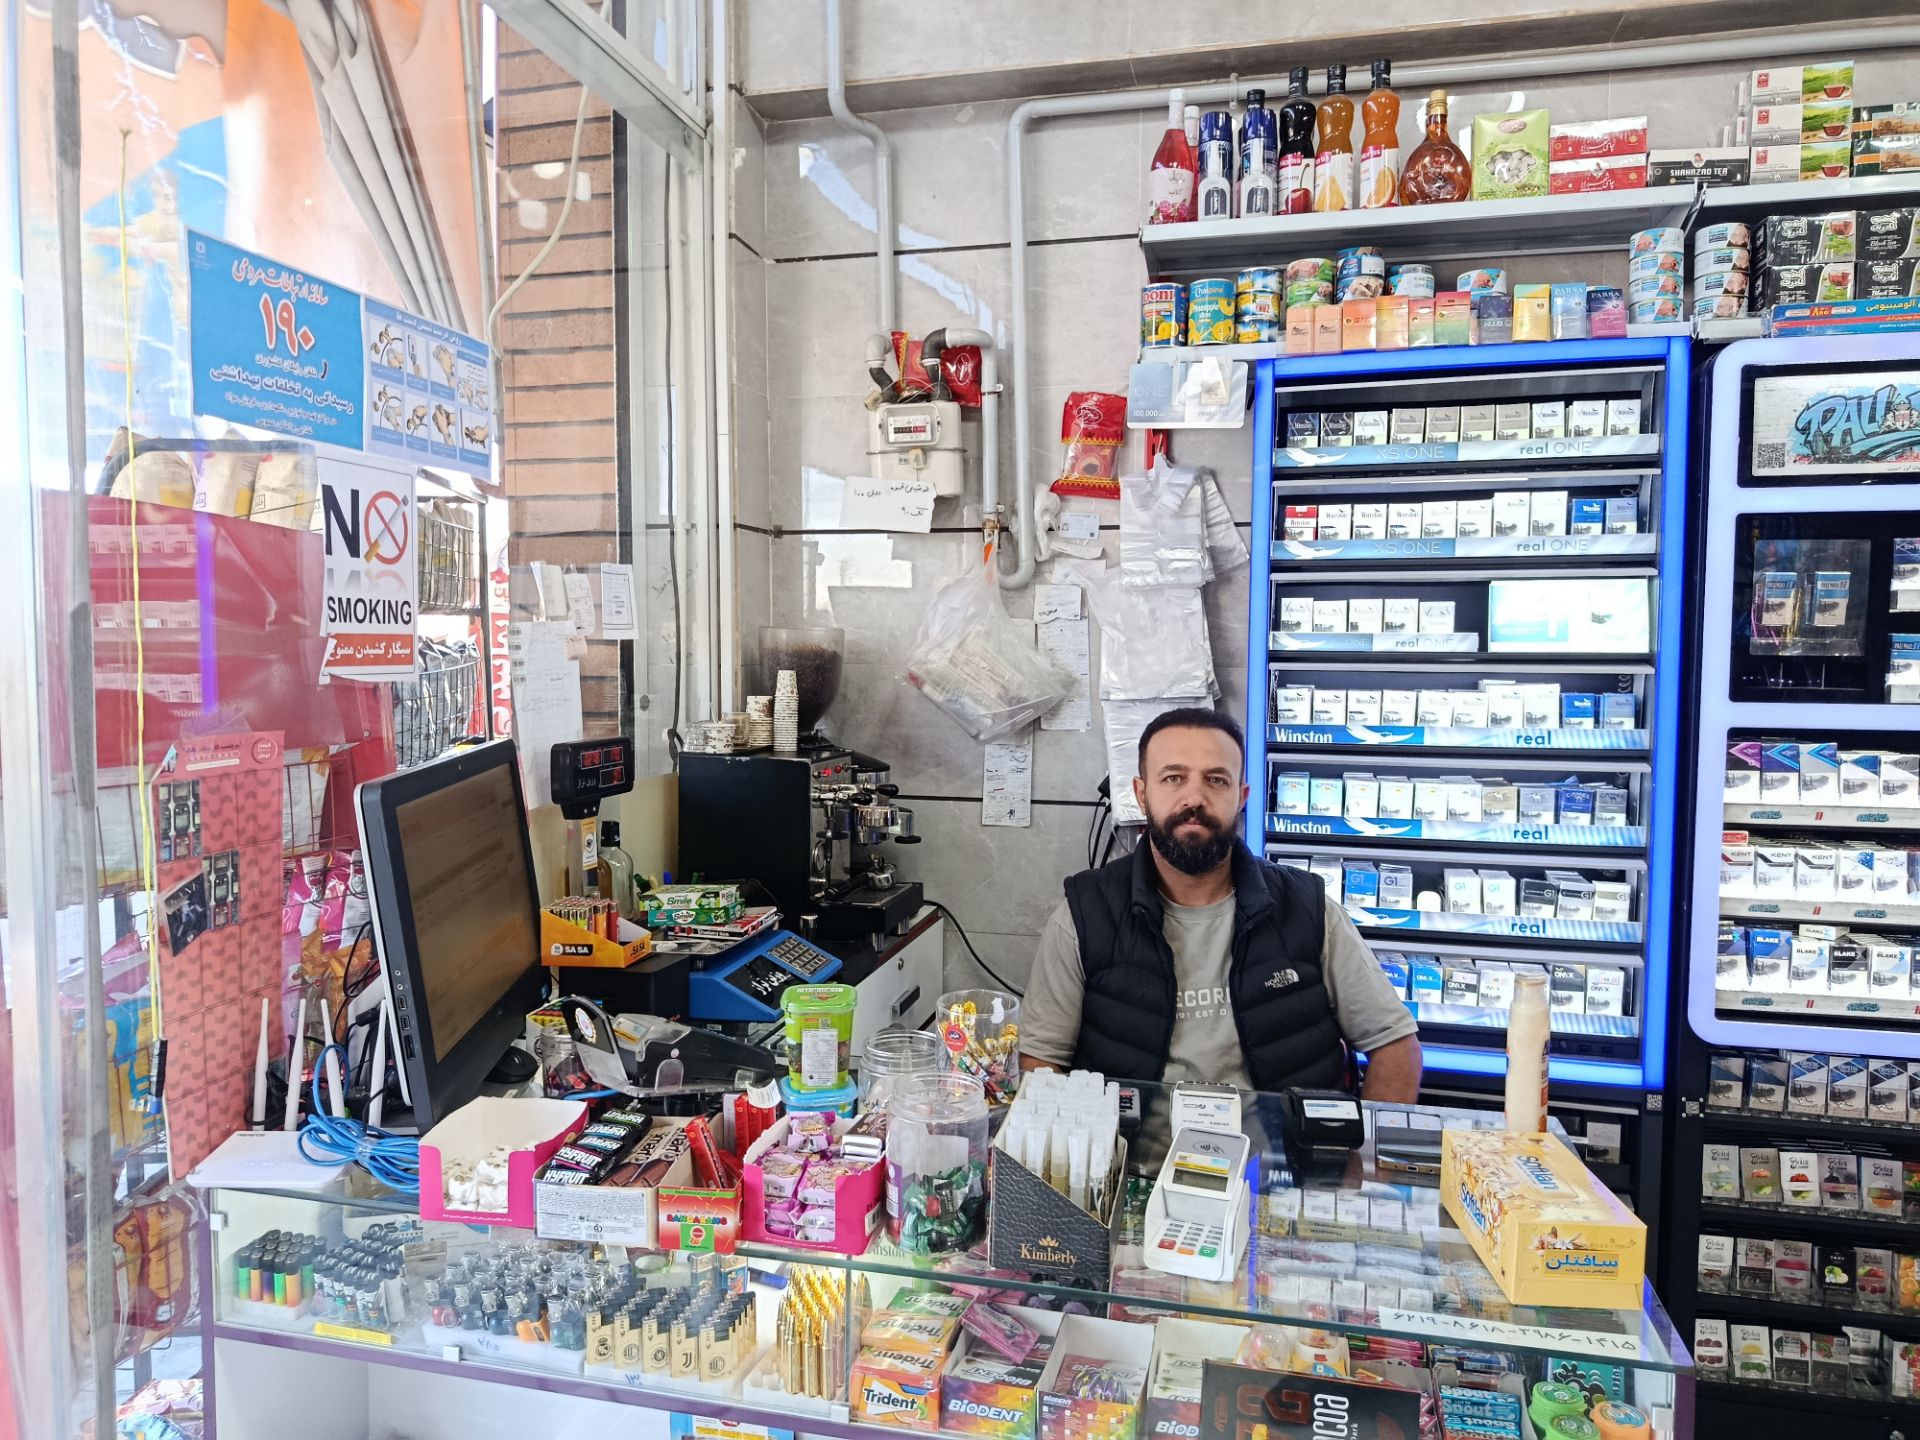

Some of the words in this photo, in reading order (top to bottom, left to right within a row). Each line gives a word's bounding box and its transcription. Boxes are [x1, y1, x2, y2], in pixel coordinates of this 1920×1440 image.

[232, 258, 264, 286] مردمی
[263, 270, 308, 301] ارتباطات
[1555, 287, 1583, 295] PARSA
[308, 284, 328, 304] سامانه
[260, 292, 315, 357] ۱۹۰
[210, 364, 261, 390] بهداشتی
[263, 375, 301, 396] تخلفات
[1134, 384, 1164, 397] ONE
[303, 388, 313, 402] به
[315, 392, 353, 414] رسیدگی
[1375, 448, 1399, 459] XS
[1405, 446, 1444, 459] ONE
[1520, 442, 1548, 454] real
[1554, 441, 1592, 453] ONE
[1373, 543, 1396, 554] XS
[1402, 542, 1441, 554] ONE
[1517, 539, 1545, 551] real
[1550, 538, 1589, 550] ONE
[327, 596, 412, 624] SMOKING
[356, 641, 386, 658] کشیدن
[387, 642, 411, 658] سیگار
[1395, 638, 1418, 648] real
[1423, 639, 1453, 648] ONE
[1274, 727, 1332, 743] Winston
[1516, 730, 1551, 745] real
[1274, 817, 1331, 833] Winston
[1514, 826, 1548, 840] real
[1351, 874, 1364, 882] G1
[1384, 876, 1398, 886] G1
[1454, 882, 1466, 890] G1
[1488, 884, 1500, 892] G1
[667, 897, 692, 905] Smile
[1581, 891, 1592, 899] G1
[1511, 920, 1546, 934] real
[564, 945, 576, 954] SA
[577, 945, 589, 954] SA
[1196, 1010, 1214, 1018] EST
[555, 1146, 602, 1166] HYFRUIT
[543, 1169, 590, 1184] HYFRUIT
[1518, 1156, 1559, 1192] Softlan
[1461, 1183, 1486, 1230] Softlan
[1020, 1243, 1077, 1265] Kimberly
[1546, 1254, 1618, 1270] سافتلن
[905, 1294, 970, 1318] Trident
[879, 1318, 944, 1343] Trident
[872, 1349, 937, 1372] Trident
[864, 1388, 918, 1410] Trident
[1443, 1401, 1492, 1416] Spout
